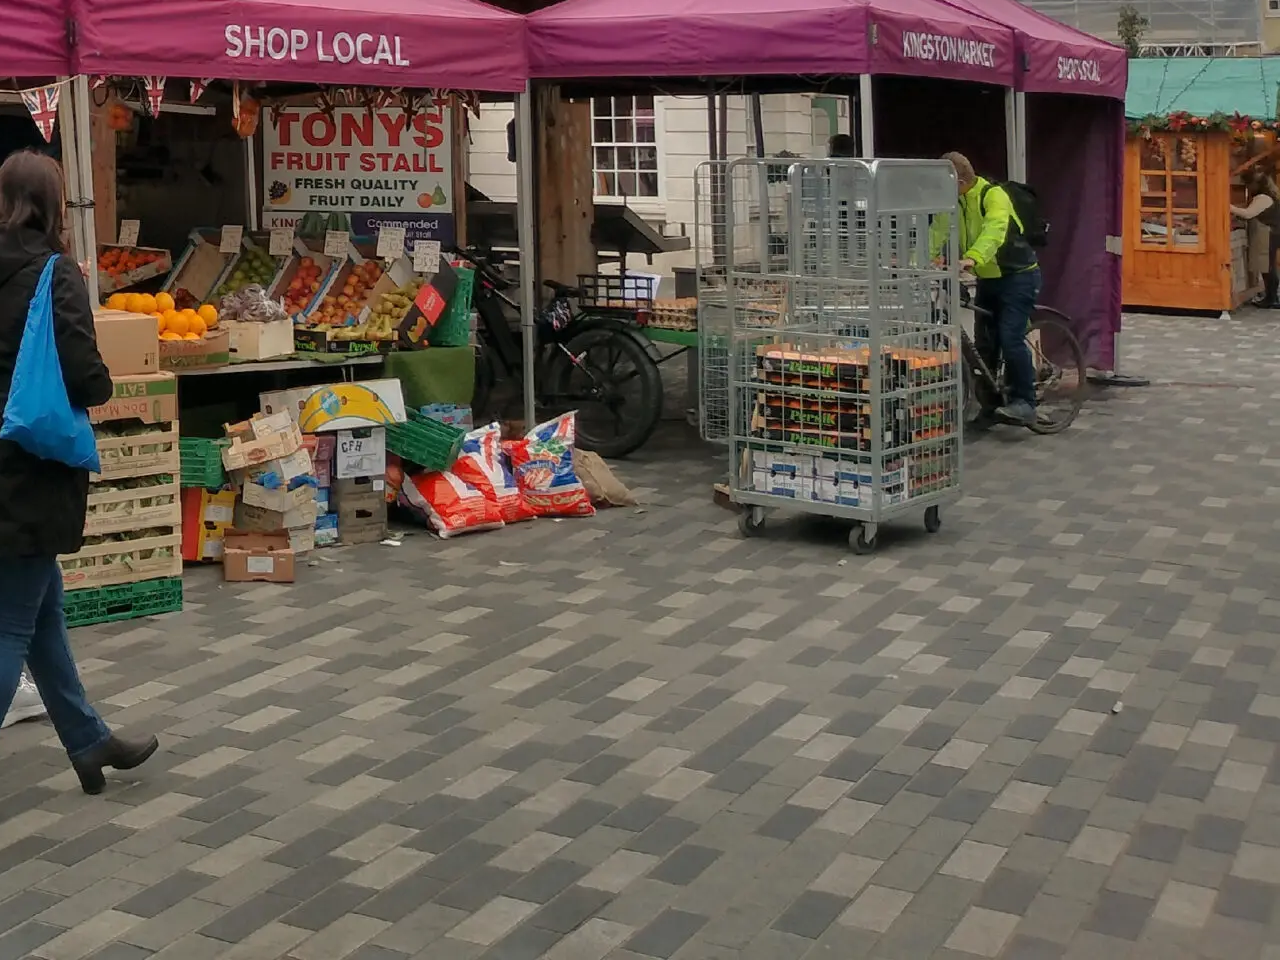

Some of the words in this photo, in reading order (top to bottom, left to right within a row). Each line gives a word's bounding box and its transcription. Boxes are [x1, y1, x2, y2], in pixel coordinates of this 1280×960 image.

[224, 24, 309, 61] SHOP
[316, 30, 410, 67] LOCAL
[902, 31, 956, 63] KINGSTON
[956, 36, 996, 68] MARKET
[1057, 55, 1079, 80] SHOP
[1079, 58, 1101, 82] LOCAL
[278, 112, 445, 148] TONYS
[271, 152, 350, 171] FRUIT
[360, 153, 444, 173] STALL
[295, 177, 345, 190] FRESH
[350, 178, 419, 192] QUALITY
[309, 195, 355, 208] FRUIT
[360, 195, 405, 208] DAILY
[367, 218, 439, 230] Commended
[349, 341, 380, 353] Persik
[789, 361, 837, 378] Persik
[121, 383, 147, 397] EAT
[790, 410, 837, 426] Persik
[341, 441, 363, 453] CFH
